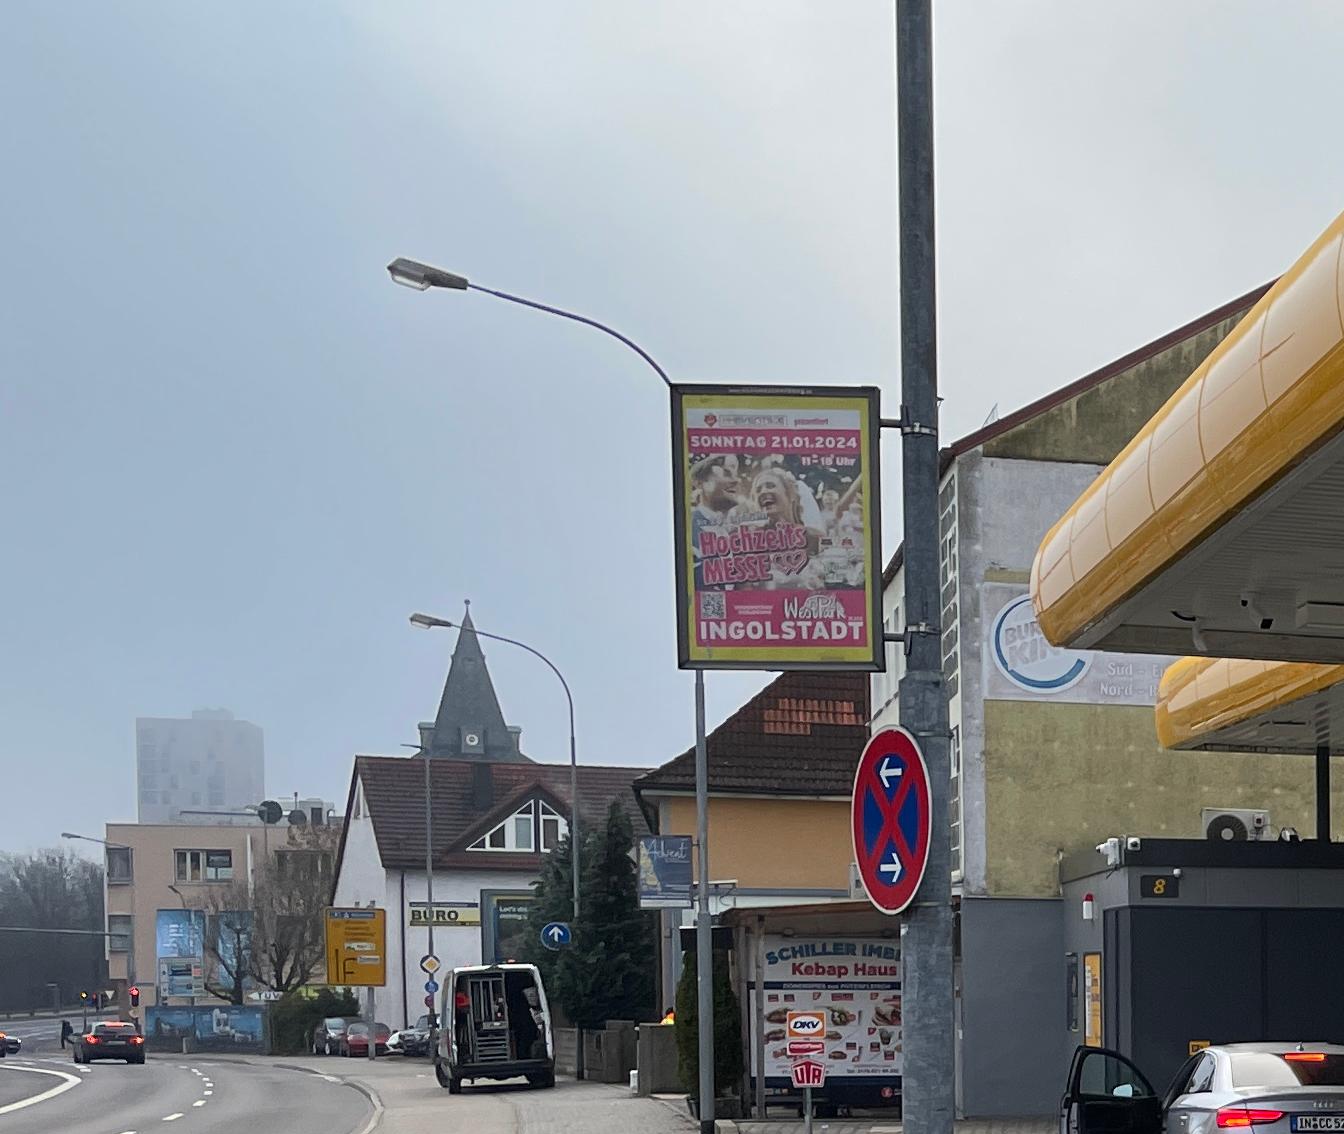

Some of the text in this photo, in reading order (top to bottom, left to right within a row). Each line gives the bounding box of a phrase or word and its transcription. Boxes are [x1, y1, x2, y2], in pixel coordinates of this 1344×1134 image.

[691, 435, 858, 449] SONNTAG 21.01.2024
[836, 456, 856, 466] Uhr
[699, 521, 808, 557] Hochzeits
[702, 553, 773, 585] MESSE
[700, 621, 864, 641] INGOLSTADT
[1100, 681, 1133, 696] Nord
[1153, 878, 1166, 895] 8
[765, 942, 901, 965] SCHILLER IMBI
[791, 962, 897, 978] Kebap Haus
[793, 1020, 820, 1029] DKV
[793, 1061, 823, 1084] UTA
[1299, 1117, 1312, 1129] IN
[1319, 1117, 1333, 1129] CC
